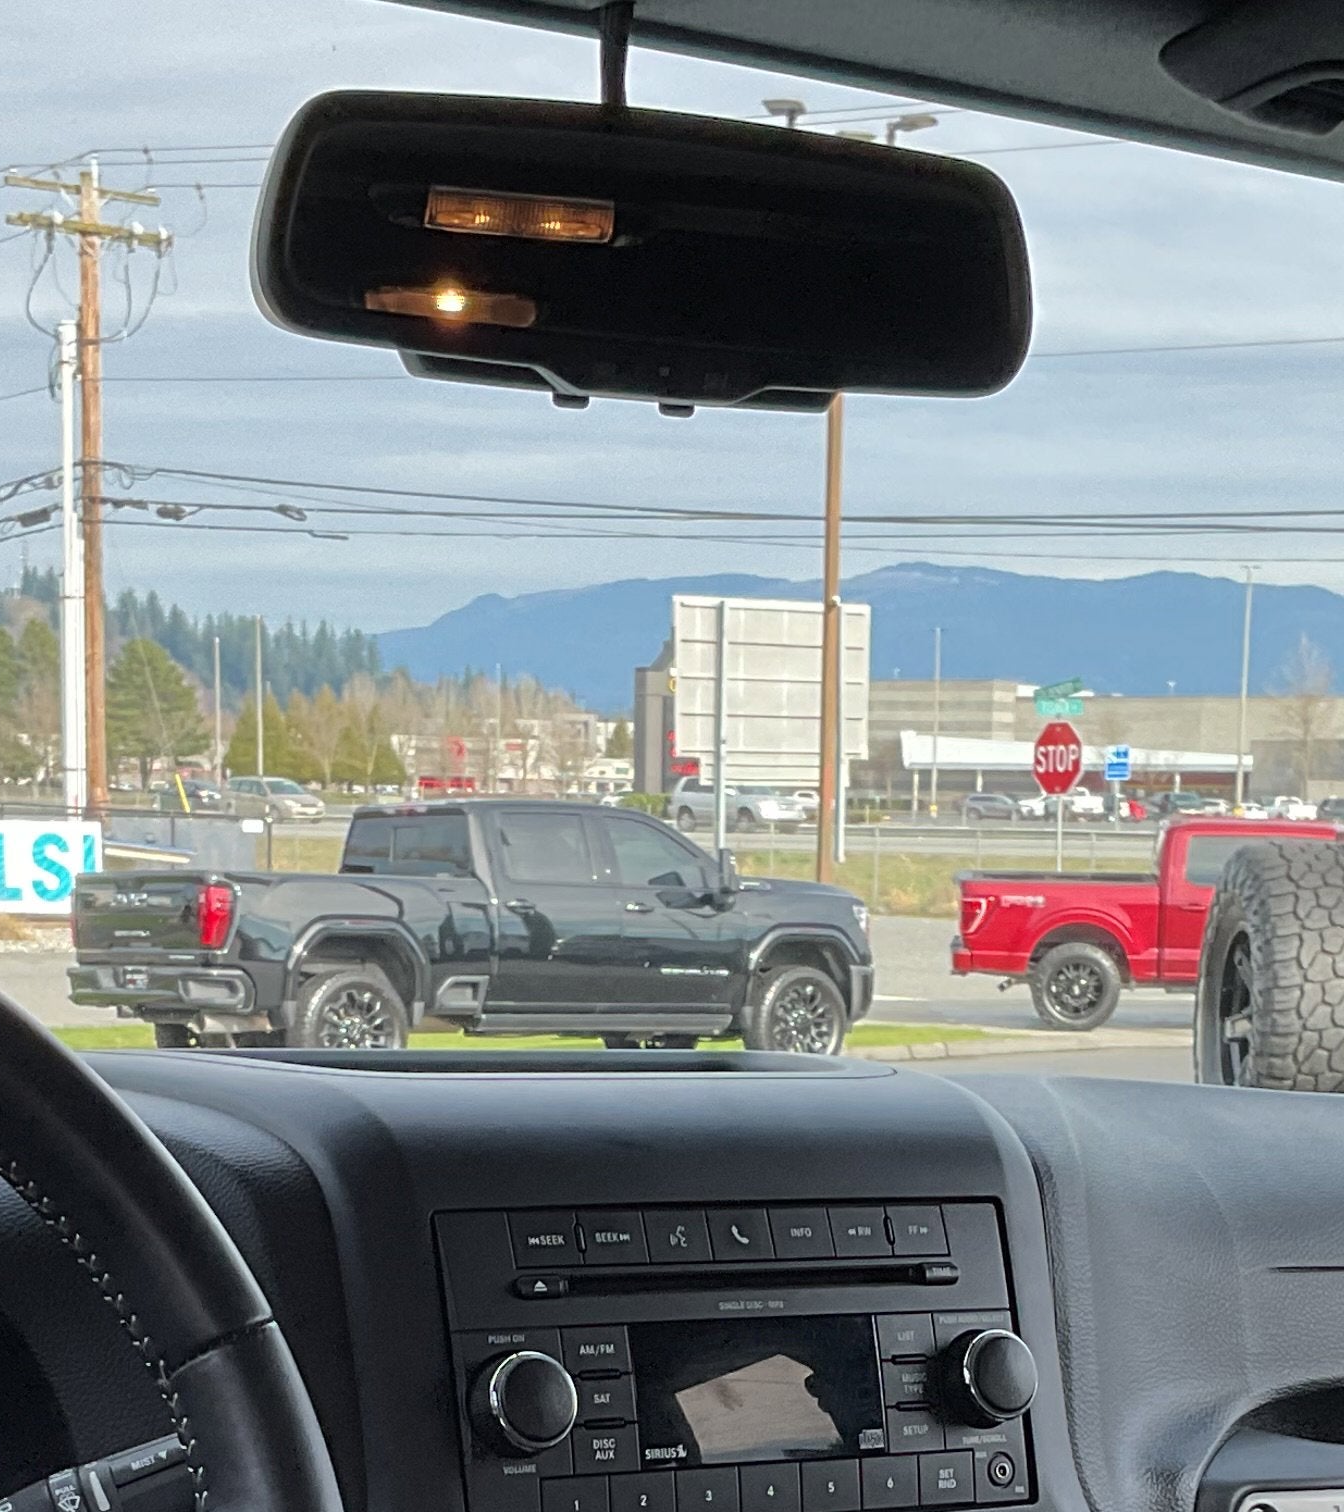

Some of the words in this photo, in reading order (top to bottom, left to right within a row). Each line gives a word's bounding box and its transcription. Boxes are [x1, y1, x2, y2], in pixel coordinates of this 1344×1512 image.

[1036, 743, 1079, 774] STOP
[790, 1227, 812, 1238] INFO
[540, 1234, 565, 1246] SEEK
[579, 1344, 615, 1355] AM/FM
[593, 1394, 610, 1404] SAT
[902, 1424, 928, 1436] SETUP
[592, 1438, 616, 1450] DISC
[595, 1450, 615, 1460] AUX
[131, 1455, 156, 1471] MIST
[503, 1464, 536, 1475] VOLUME
[938, 1468, 954, 1479] SET
[828, 1482, 835, 1492] 5
[887, 1477, 894, 1489] 6
[938, 1479, 956, 1489] RND
[705, 1490, 712, 1501] 3
[767, 1485, 774, 1496] 4
[574, 1500, 580, 1511] 1
[640, 1495, 647, 1506] 2
